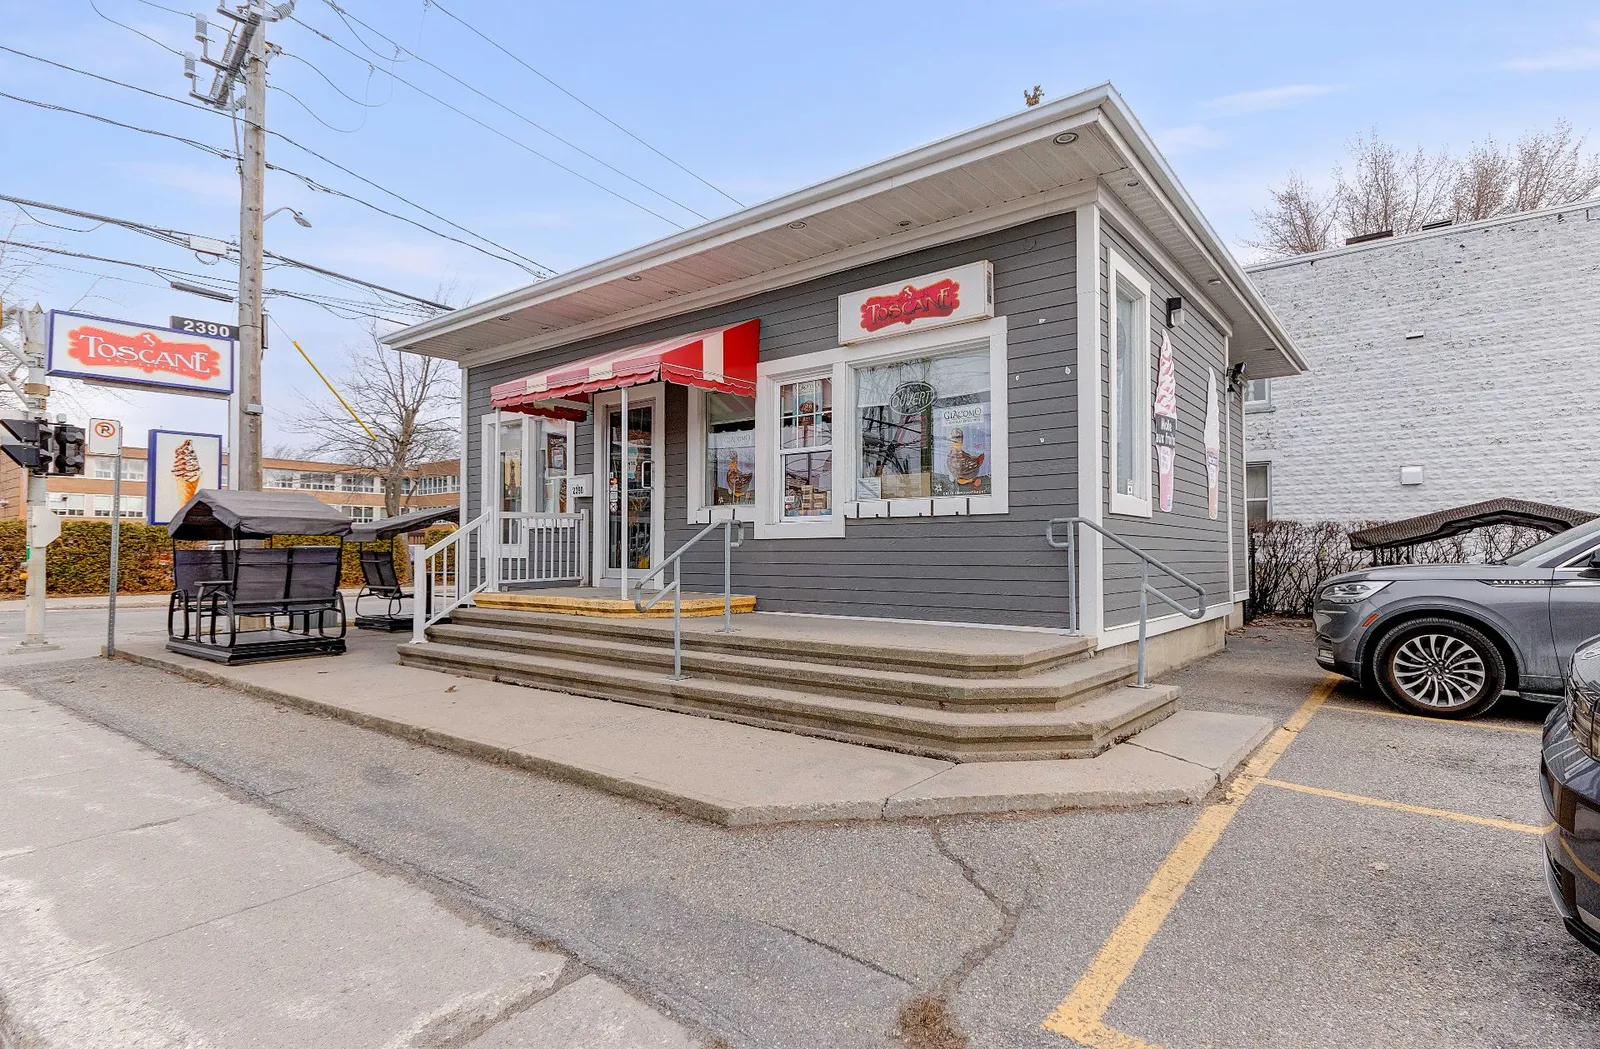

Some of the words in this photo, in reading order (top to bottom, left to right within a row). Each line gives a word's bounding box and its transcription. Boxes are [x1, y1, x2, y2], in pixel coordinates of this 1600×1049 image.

[866, 287, 954, 325] TOSCANE
[183, 320, 230, 338] 2390
[79, 334, 211, 374] TOSCANE
[892, 390, 933, 408] OUVERT
[943, 407, 982, 420] GIACOMO
